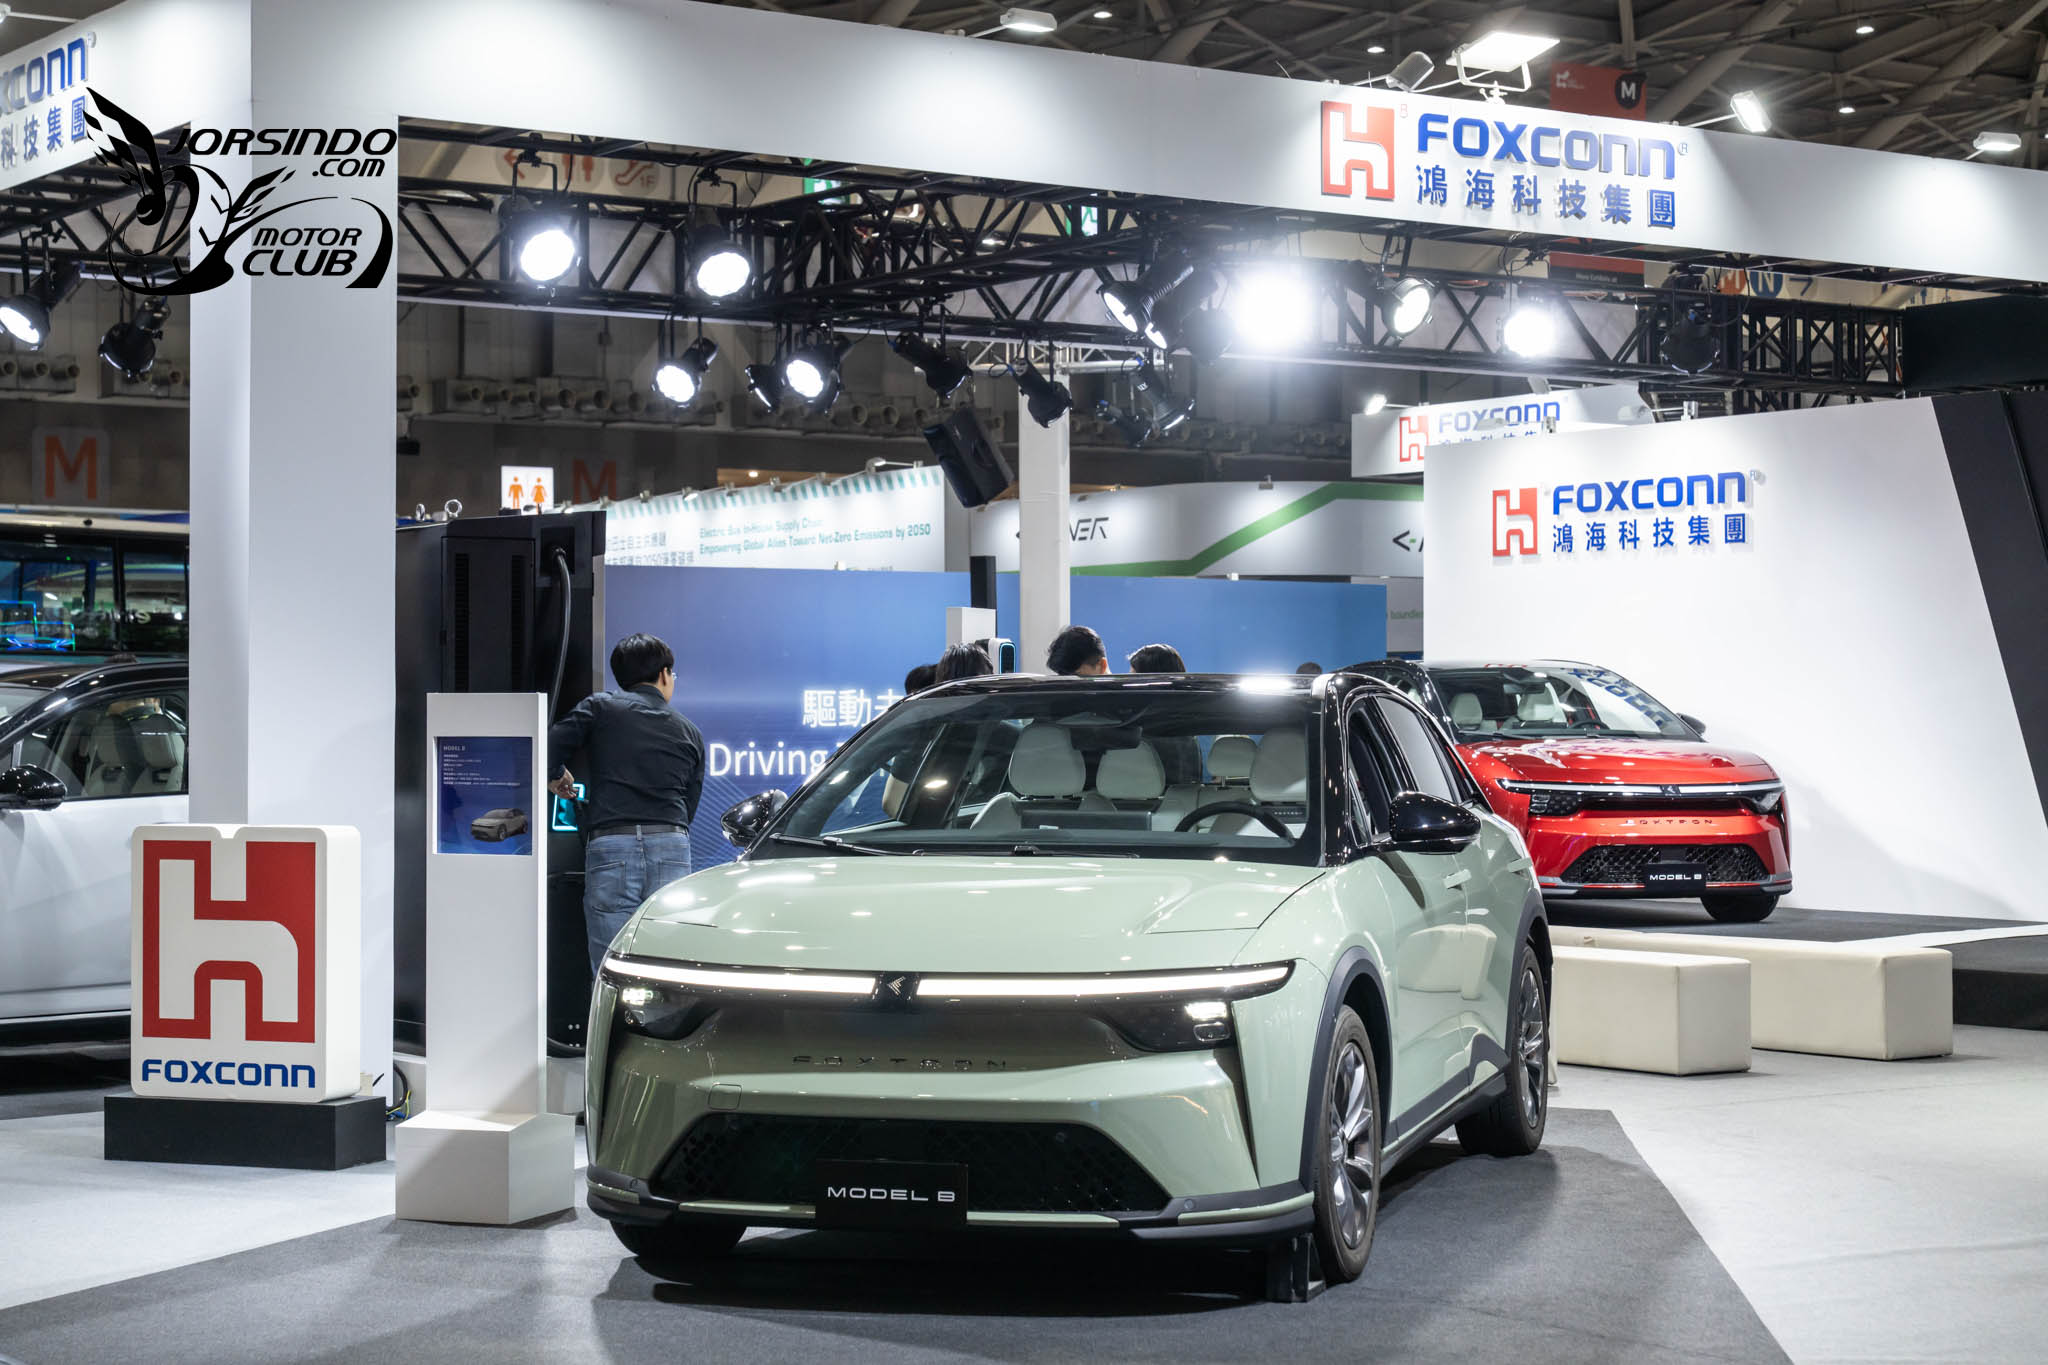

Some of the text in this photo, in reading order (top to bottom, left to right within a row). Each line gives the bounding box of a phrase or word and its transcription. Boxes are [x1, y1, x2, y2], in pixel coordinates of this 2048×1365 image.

[1621, 82, 1636, 99] M
[1416, 164, 1676, 229] 鴻海科技集團
[44, 435, 97, 501] M
[818, 530, 852, 544] Net-Zero
[854, 527, 893, 541] Emissions
[895, 526, 906, 540] by
[907, 523, 931, 537] 2050
[1553, 513, 1746, 552] 鴻海科技集團
[709, 741, 828, 778] Driving
[141, 1058, 316, 1088] FOXCONN
[827, 1186, 955, 1202] MODEL B
